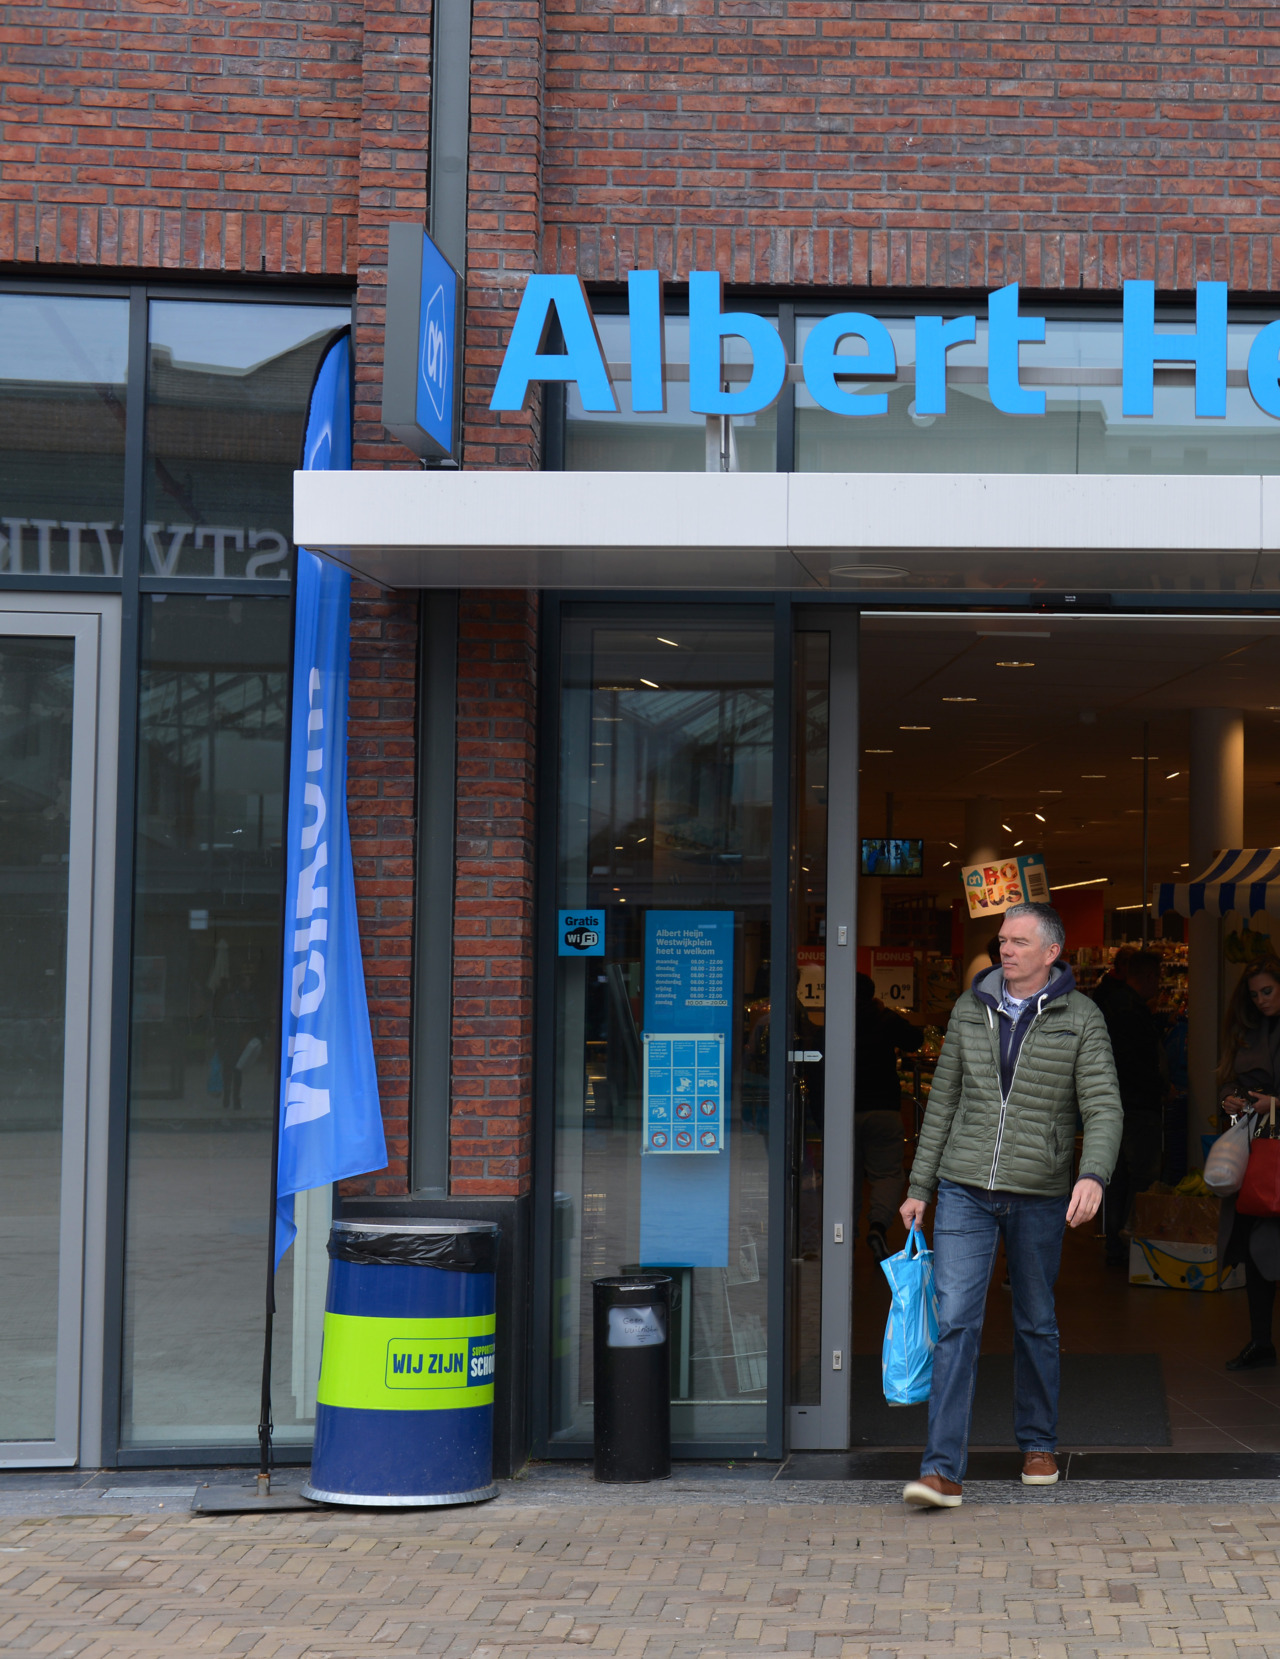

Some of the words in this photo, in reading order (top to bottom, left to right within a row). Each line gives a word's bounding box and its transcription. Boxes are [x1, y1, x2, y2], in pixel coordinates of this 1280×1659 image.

[489, 269, 1047, 417] Albert
[565, 915, 599, 926] Gratis
[656, 929, 681, 937] Albert
[683, 929, 704, 938] Heijn
[656, 938, 712, 947] Westwijkplein
[656, 947, 674, 955] heet
[683, 947, 715, 955] welkom
[876, 951, 911, 961] BONUS
[392, 1353, 424, 1374] WIJ
[428, 1352, 464, 1374] ZIJN
